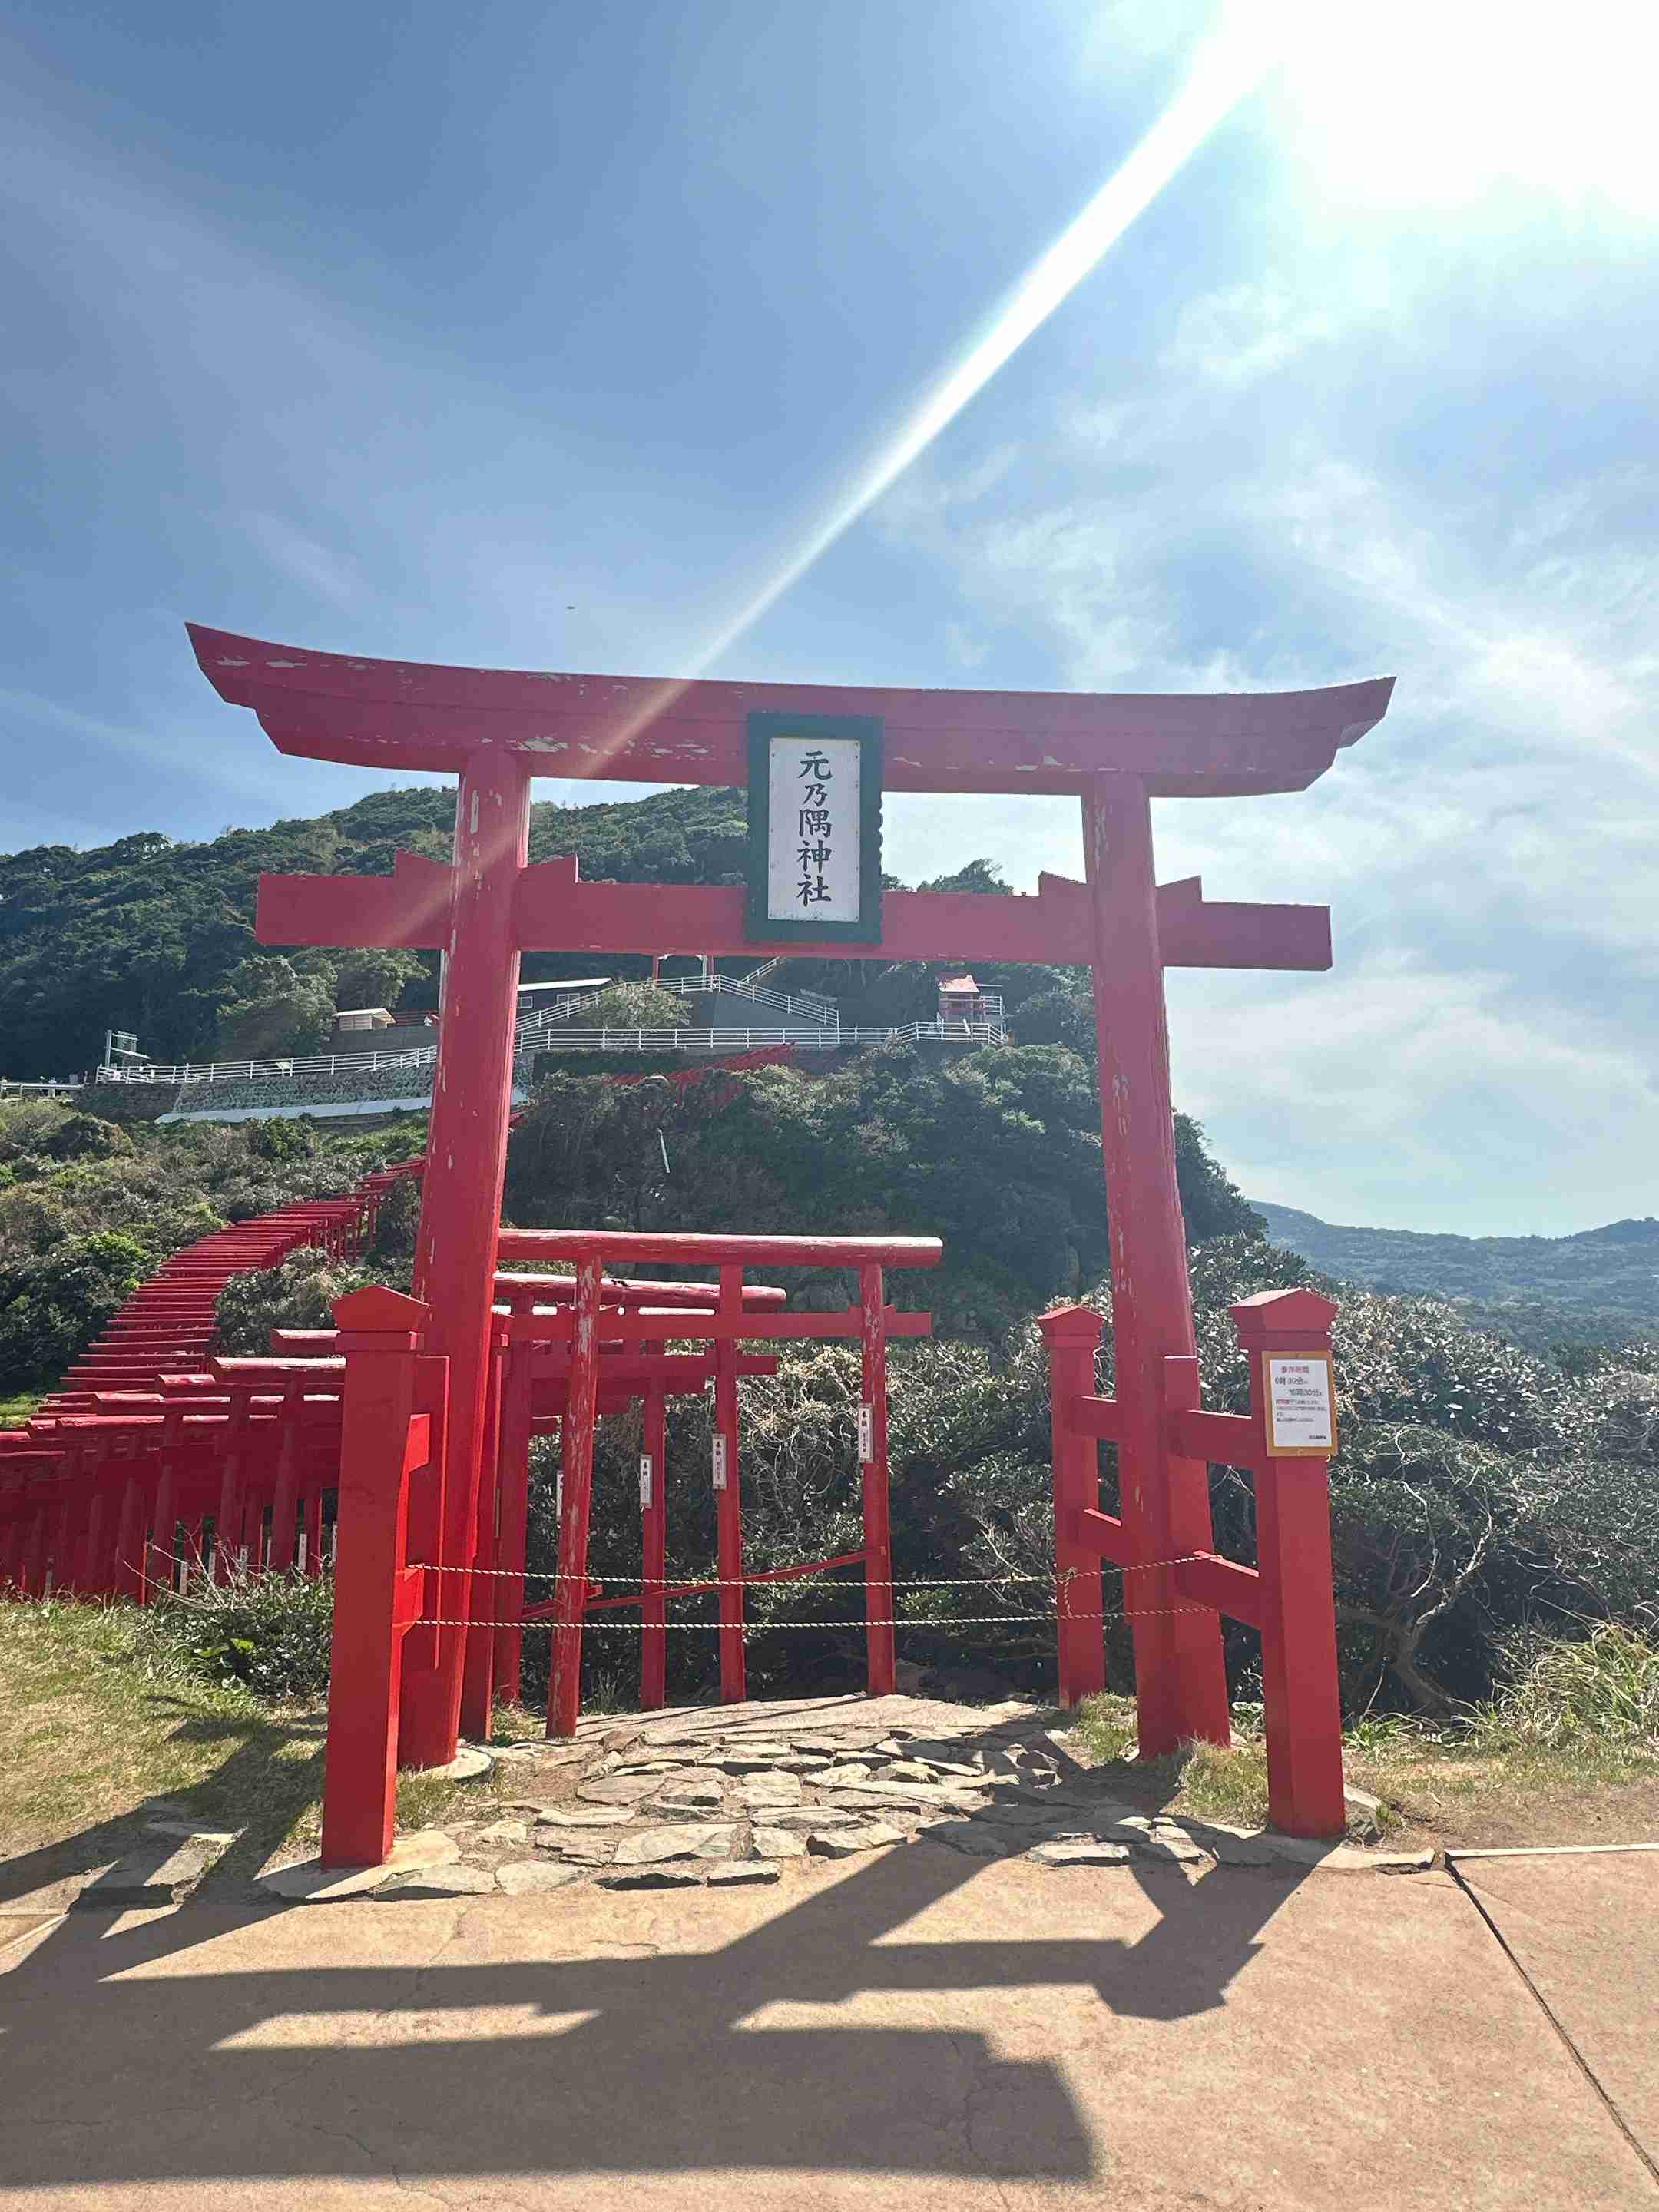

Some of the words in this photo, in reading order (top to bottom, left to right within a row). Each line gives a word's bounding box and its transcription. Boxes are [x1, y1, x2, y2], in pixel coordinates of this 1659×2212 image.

[796, 750, 833, 907] 元乃隅神社
